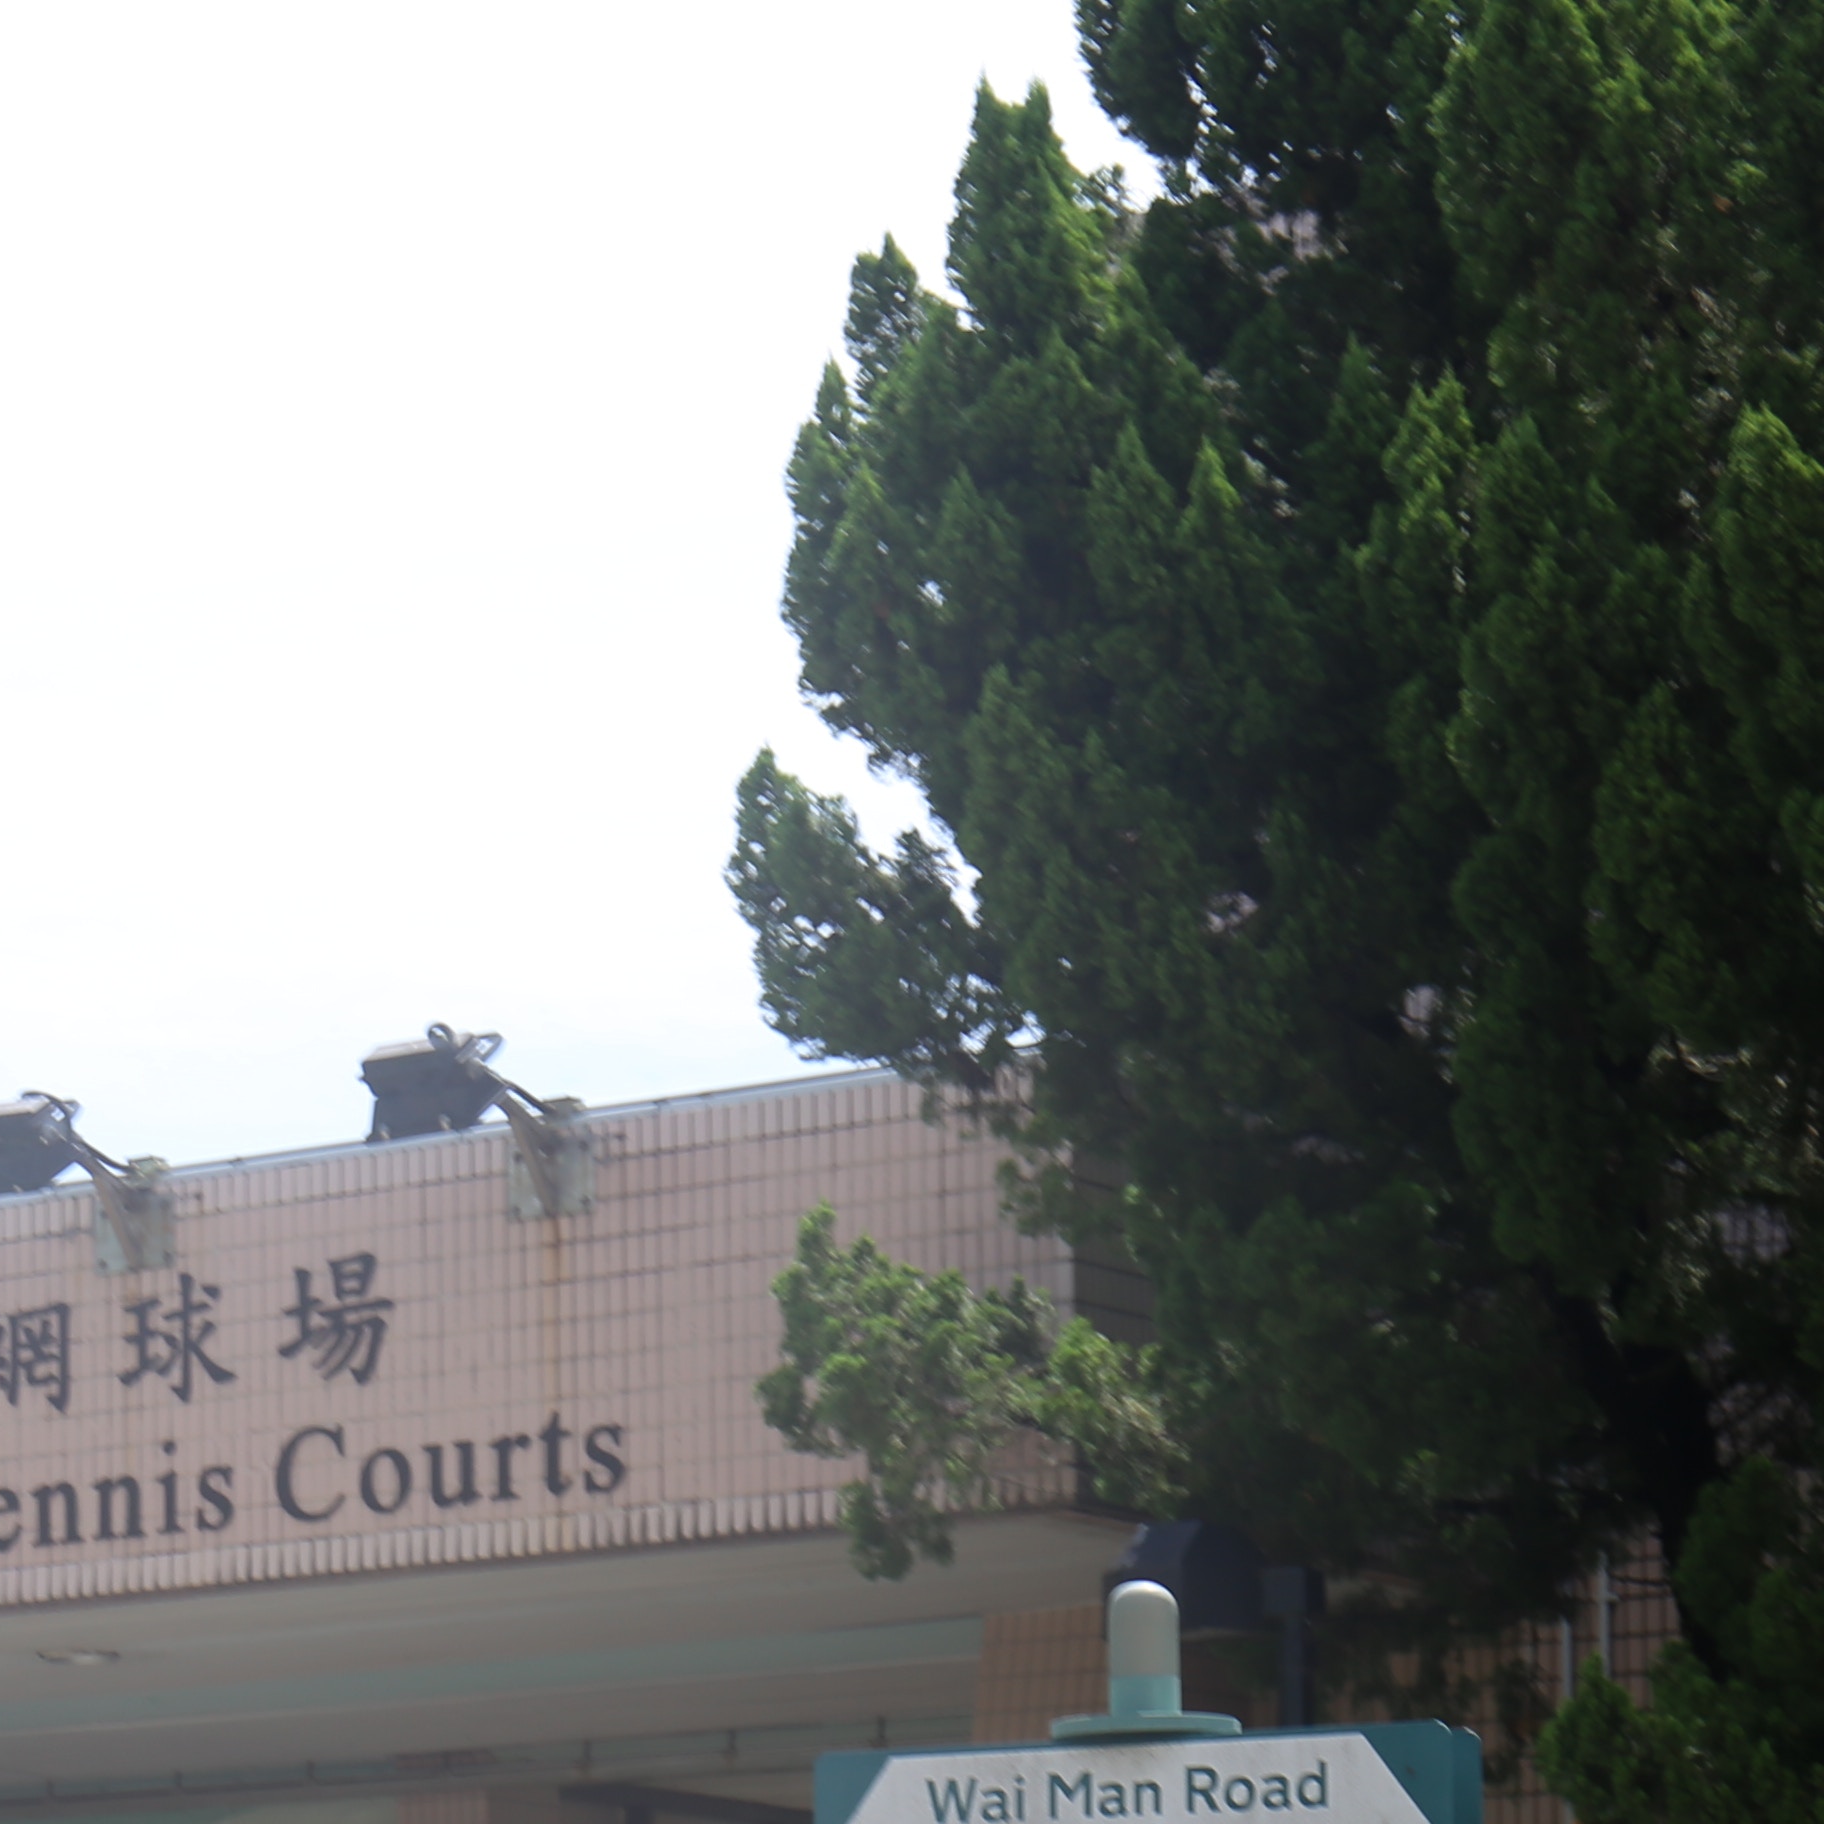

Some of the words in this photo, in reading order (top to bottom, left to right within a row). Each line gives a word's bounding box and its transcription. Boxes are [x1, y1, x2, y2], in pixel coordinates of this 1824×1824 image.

[273, 1410, 629, 1526] Courts
[1052, 1770, 1163, 1820] Man
[1185, 1760, 1330, 1816] Road
